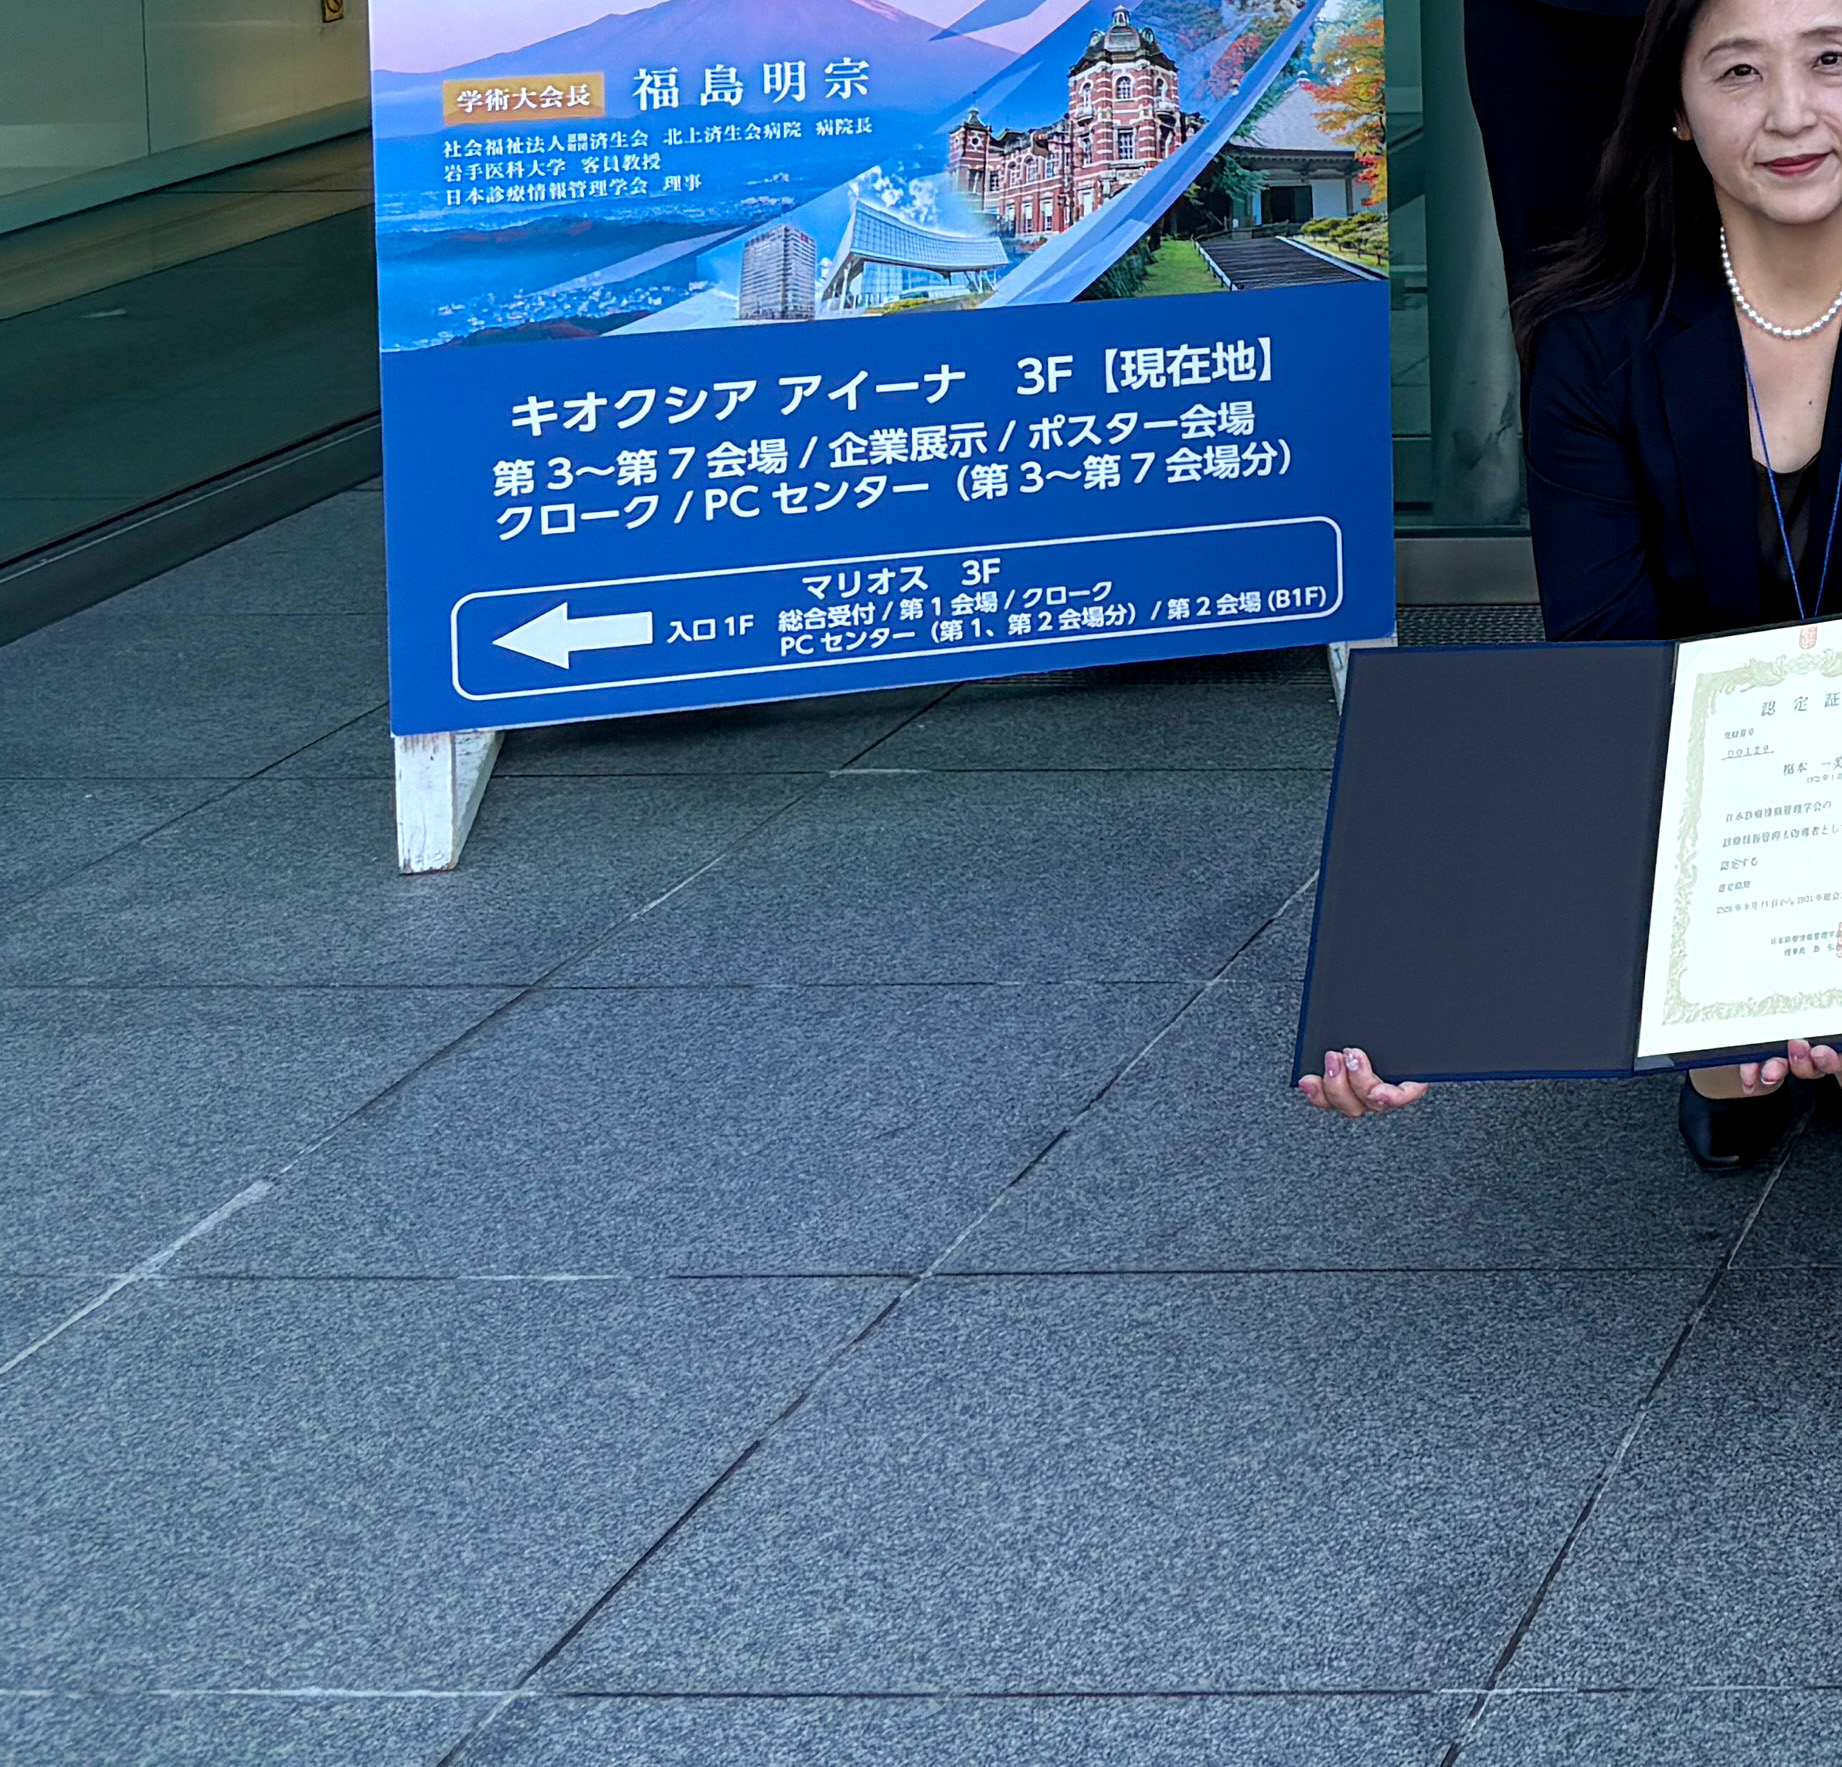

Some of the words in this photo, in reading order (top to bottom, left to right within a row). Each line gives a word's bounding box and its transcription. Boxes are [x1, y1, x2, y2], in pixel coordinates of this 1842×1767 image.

[456, 84, 591, 114] 学術大会長
[632, 57, 871, 112] 福島明宗
[663, 120, 803, 146] 北上済生会病院
[443, 159, 567, 183] 岩手医科大学
[581, 152, 661, 174] 客員教授
[446, 176, 649, 206] 日本診療情報管理学会
[662, 174, 702, 193] 理事
[511, 379, 758, 437] キオクシア
[778, 364, 966, 415] アイーナ
[1016, 354, 1074, 396] 3F
[828, 421, 988, 469] 企業展示
[1029, 400, 1255, 450] ポスター会場
[496, 495, 659, 541] クローク
[801, 566, 928, 600] マリオス
[961, 558, 1001, 585] 3F
[778, 603, 876, 633] 総合受付
[1023, 580, 1113, 607] クローク
[667, 618, 717, 644] 入口
[728, 614, 754, 636] 1F
